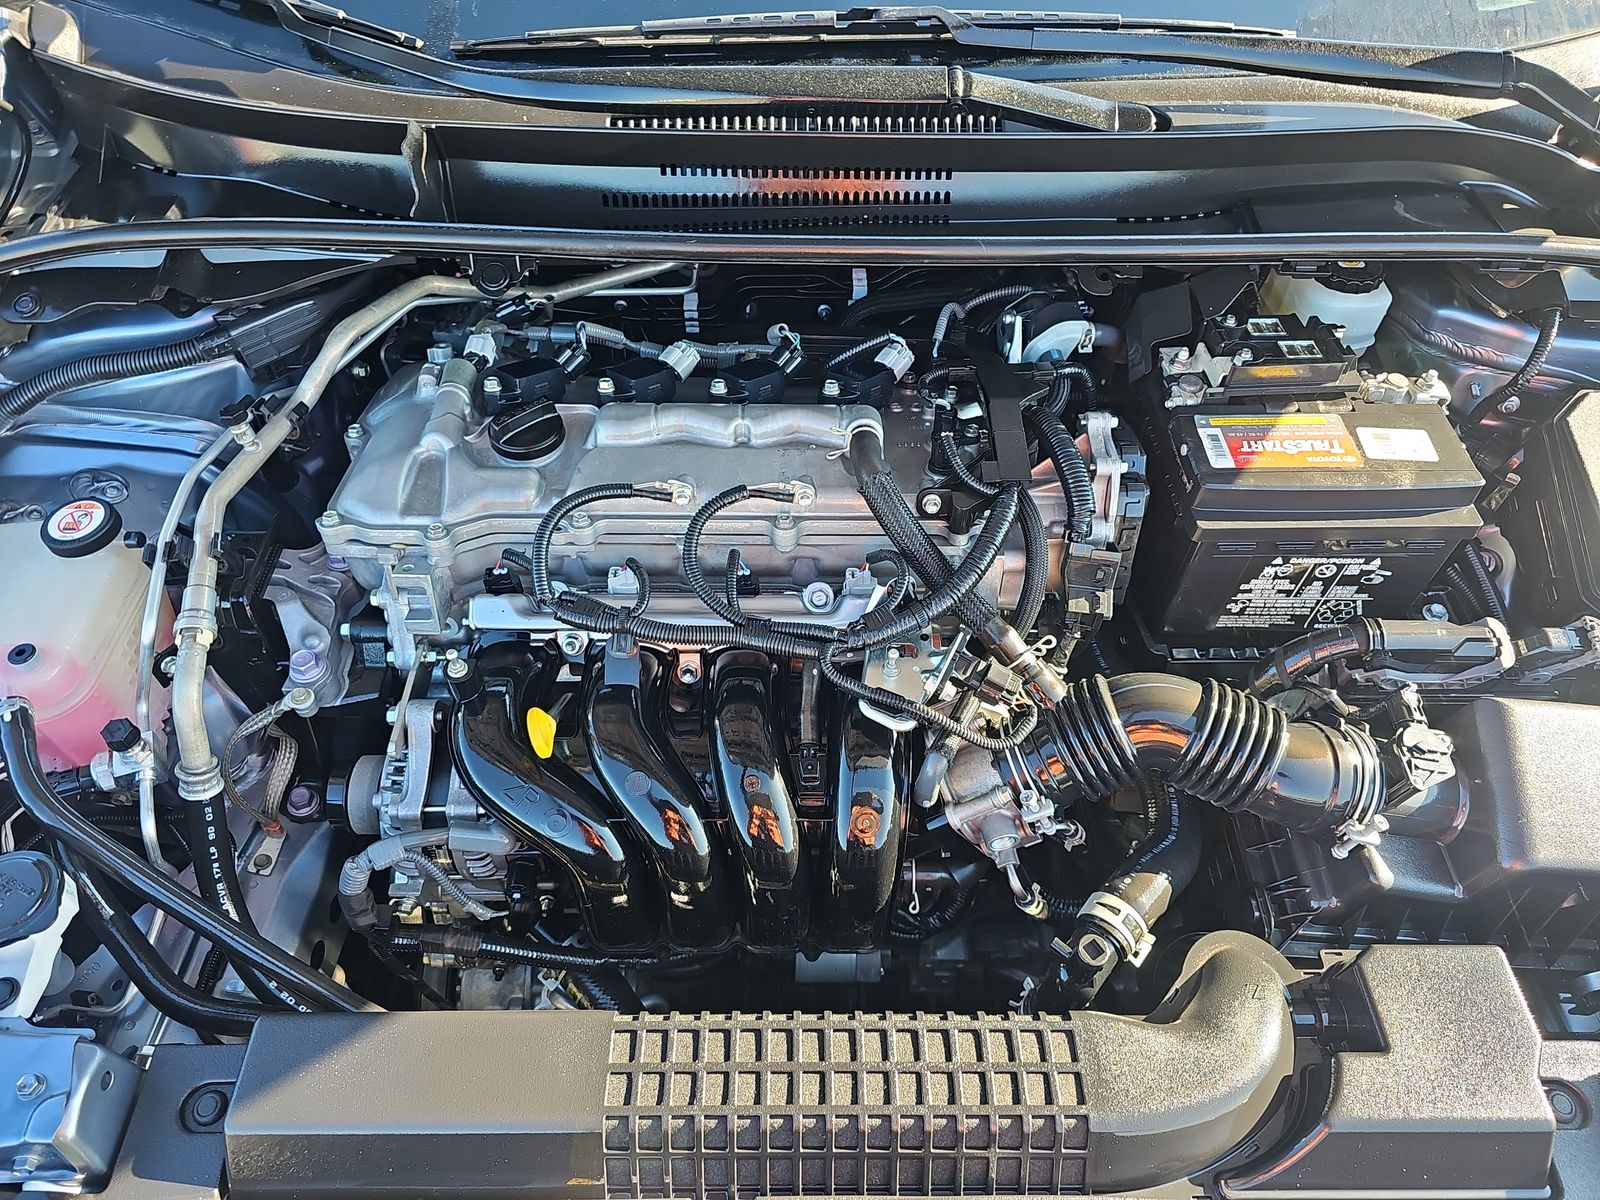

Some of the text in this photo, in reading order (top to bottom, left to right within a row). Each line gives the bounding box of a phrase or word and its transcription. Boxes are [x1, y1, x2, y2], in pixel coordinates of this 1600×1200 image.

[204, 805, 214, 822] 02
[207, 826, 216, 840] SD
[209, 846, 219, 860] LP
